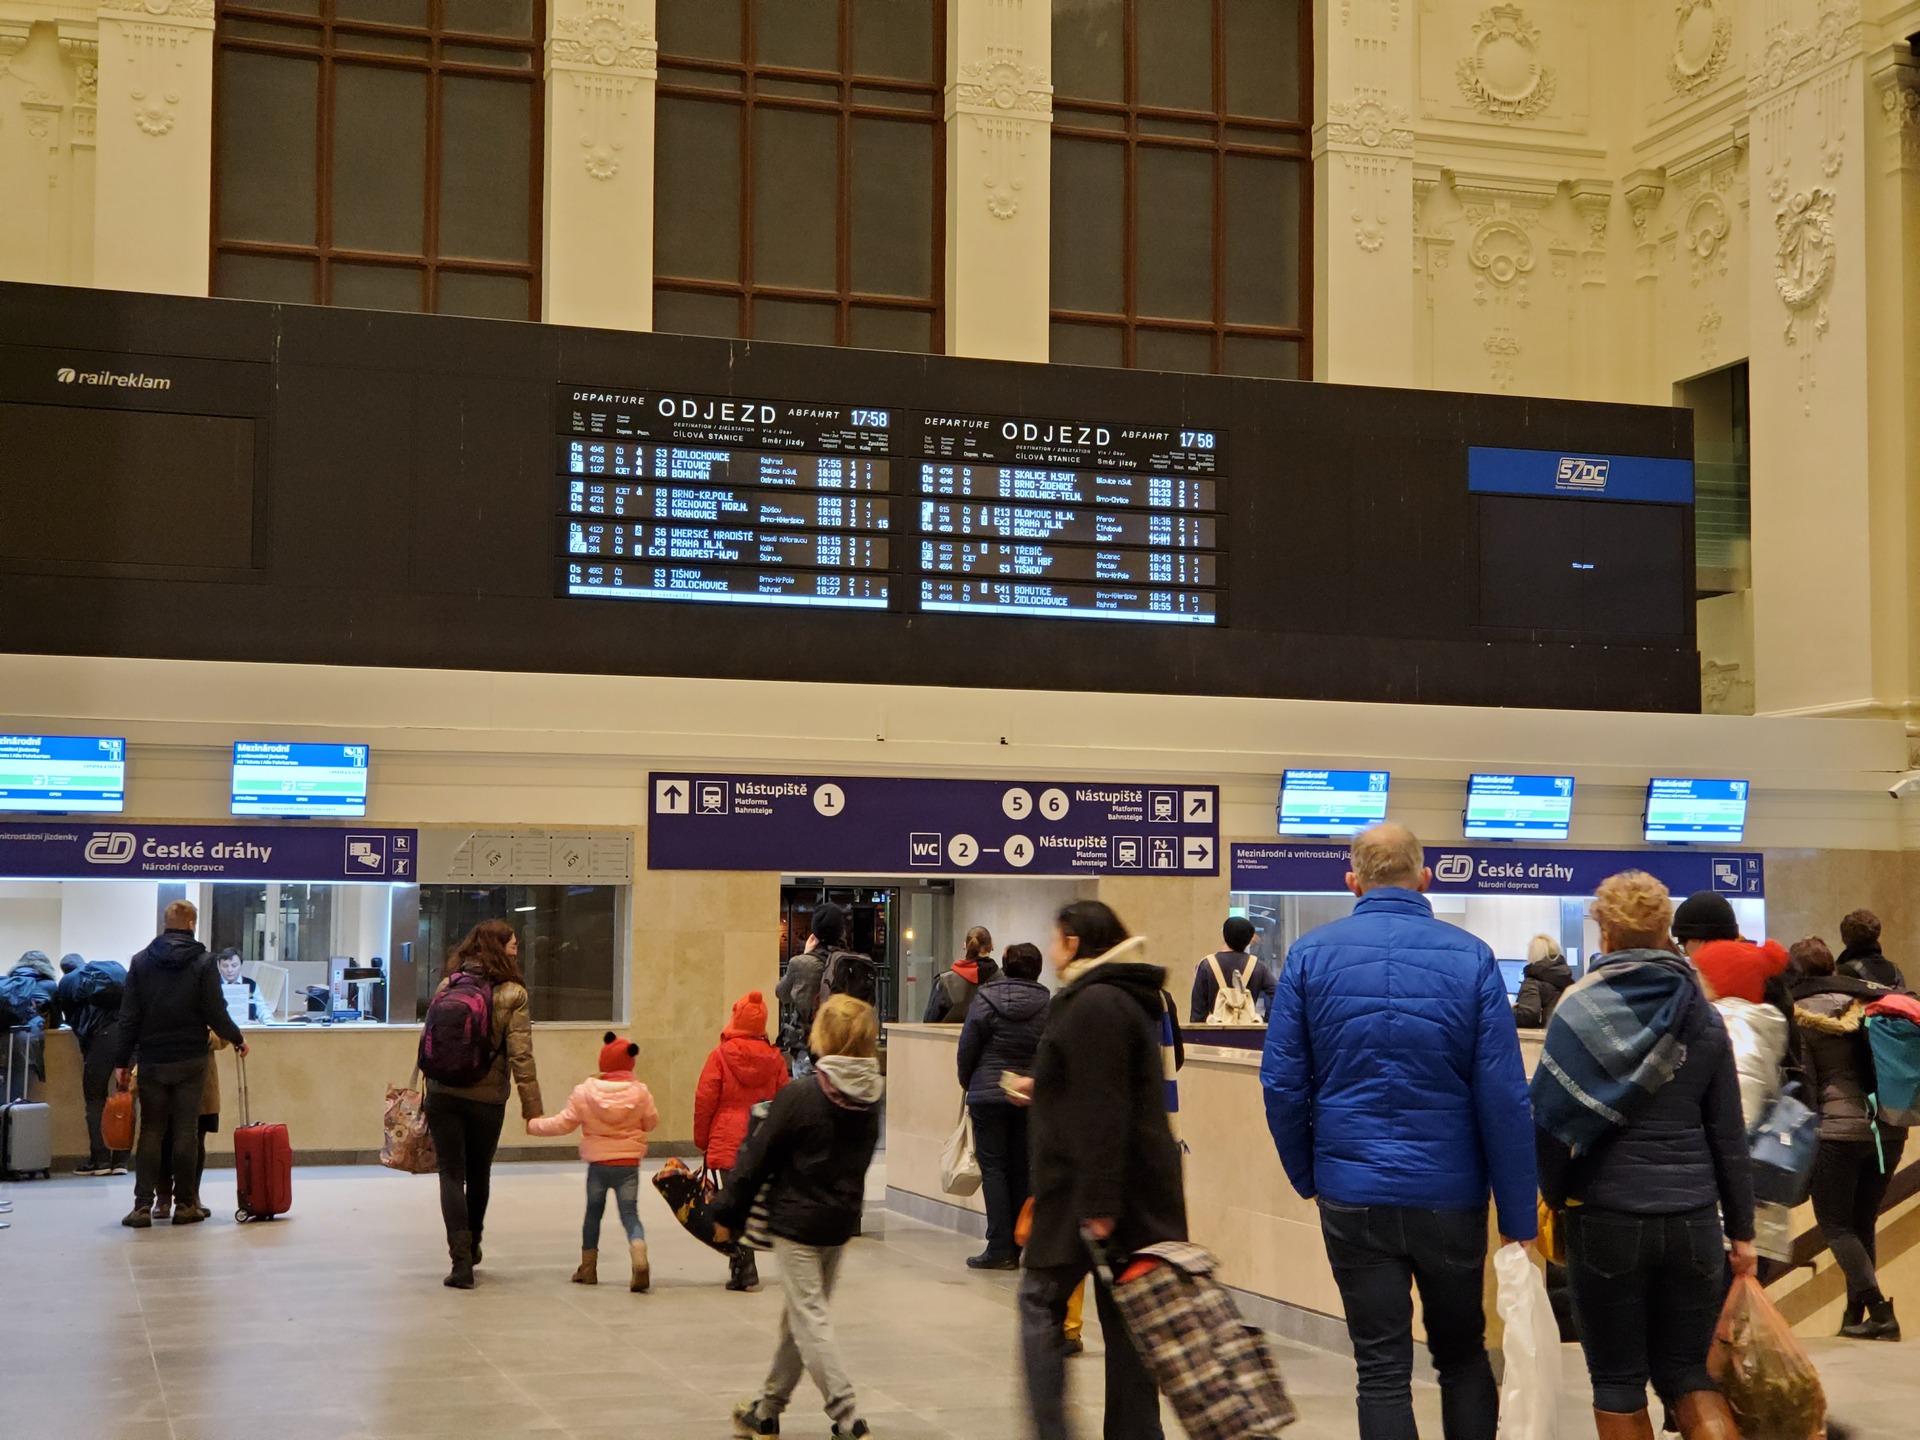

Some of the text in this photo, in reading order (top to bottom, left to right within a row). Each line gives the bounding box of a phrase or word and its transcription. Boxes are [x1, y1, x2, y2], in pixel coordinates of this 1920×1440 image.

[78, 371, 171, 390] railreklam
[573, 392, 840, 424] DEPARTURE ODJEZD ABFAHRT
[851, 410, 887, 427] 17:58
[673, 430, 744, 442] CÍLOVÁ STANICE
[925, 418, 1170, 446] DEPARTURE ODJEZD ABFAHRT
[785, 438, 805, 447] jízdy
[656, 449, 667, 458] S3
[672, 449, 730, 461] ŽIDLOCHOVICE
[818, 459, 841, 468] 17:55
[1016, 452, 1044, 461] CÍLOVÁ
[656, 459, 841, 478] S2 LETOVICE 18:00
[656, 468, 667, 477] R8
[672, 468, 709, 480] BOHUMÍN
[818, 478, 841, 487] 18:02
[1000, 470, 1010, 478] S2
[1015, 470, 1046, 480] SKALICE
[1149, 479, 1171, 488] 18:29
[1000, 479, 1171, 497] S3 BRNO-ŽIDENICE 18:33
[656, 488, 667, 497] R8
[818, 498, 842, 507] 18:03
[1000, 489, 1171, 507] S2 SOKOLNICE-TELN. 18:35
[656, 498, 667, 507] S2
[672, 498, 717, 510] KŘENOVICE
[818, 507, 842, 516] 18:06
[994, 508, 1010, 516] R13
[1015, 508, 1051, 519] OLOMOUC
[656, 508, 888, 528] S3 VRANOVICE 18:10 15
[994, 517, 1010, 526] Ex3
[1015, 518, 1040, 528] PRAHA
[655, 528, 841, 545] S6 UHERSKÉ HRADIŠTĚ 18:15
[999, 527, 1049, 537] S3 BŘECLAV
[655, 538, 666, 547] R9
[671, 539, 699, 548] PRAHA
[817, 547, 841, 555] 18:20
[1000, 546, 1171, 563] S4 TŘEBÍČ 18:43
[649, 548, 666, 557] Ex3
[817, 556, 840, 565] 18:21
[1015, 556, 1171, 572] WIEN HBF 18:48
[655, 568, 840, 586] S3 TIŠNOV 18:23
[999, 565, 1171, 581] S3 TIŠNOV 18:53
[655, 579, 666, 588] S3
[670, 578, 728, 591] ŽIDLOCHOVICE
[817, 587, 840, 595] 18:27
[994, 585, 1171, 602] S41 BOHUTICE 18:54
[1000, 595, 1171, 611] S3 ŽIDLOCHOVICE 18:55
[238, 744, 290, 753] Mezinárodní
[734, 798, 768, 806] Platforms
[735, 782, 834, 807] Nástupiště 1
[1013, 790, 1143, 811] 5 6 Nástupiště
[734, 806, 773, 815] Bahnsteige
[1107, 813, 1143, 821] Bahnsteige
[142, 838, 272, 863] České dráhy
[913, 836, 1107, 858] WC 2 4 Nástupiště
[1237, 849, 1286, 858] Mezinárodní
[1294, 850, 1341, 859] vnitrostátní
[142, 862, 224, 872] Národní dopravce
[1478, 859, 1574, 882] České dráhy
[1478, 880, 1539, 890] Národní dopravce
